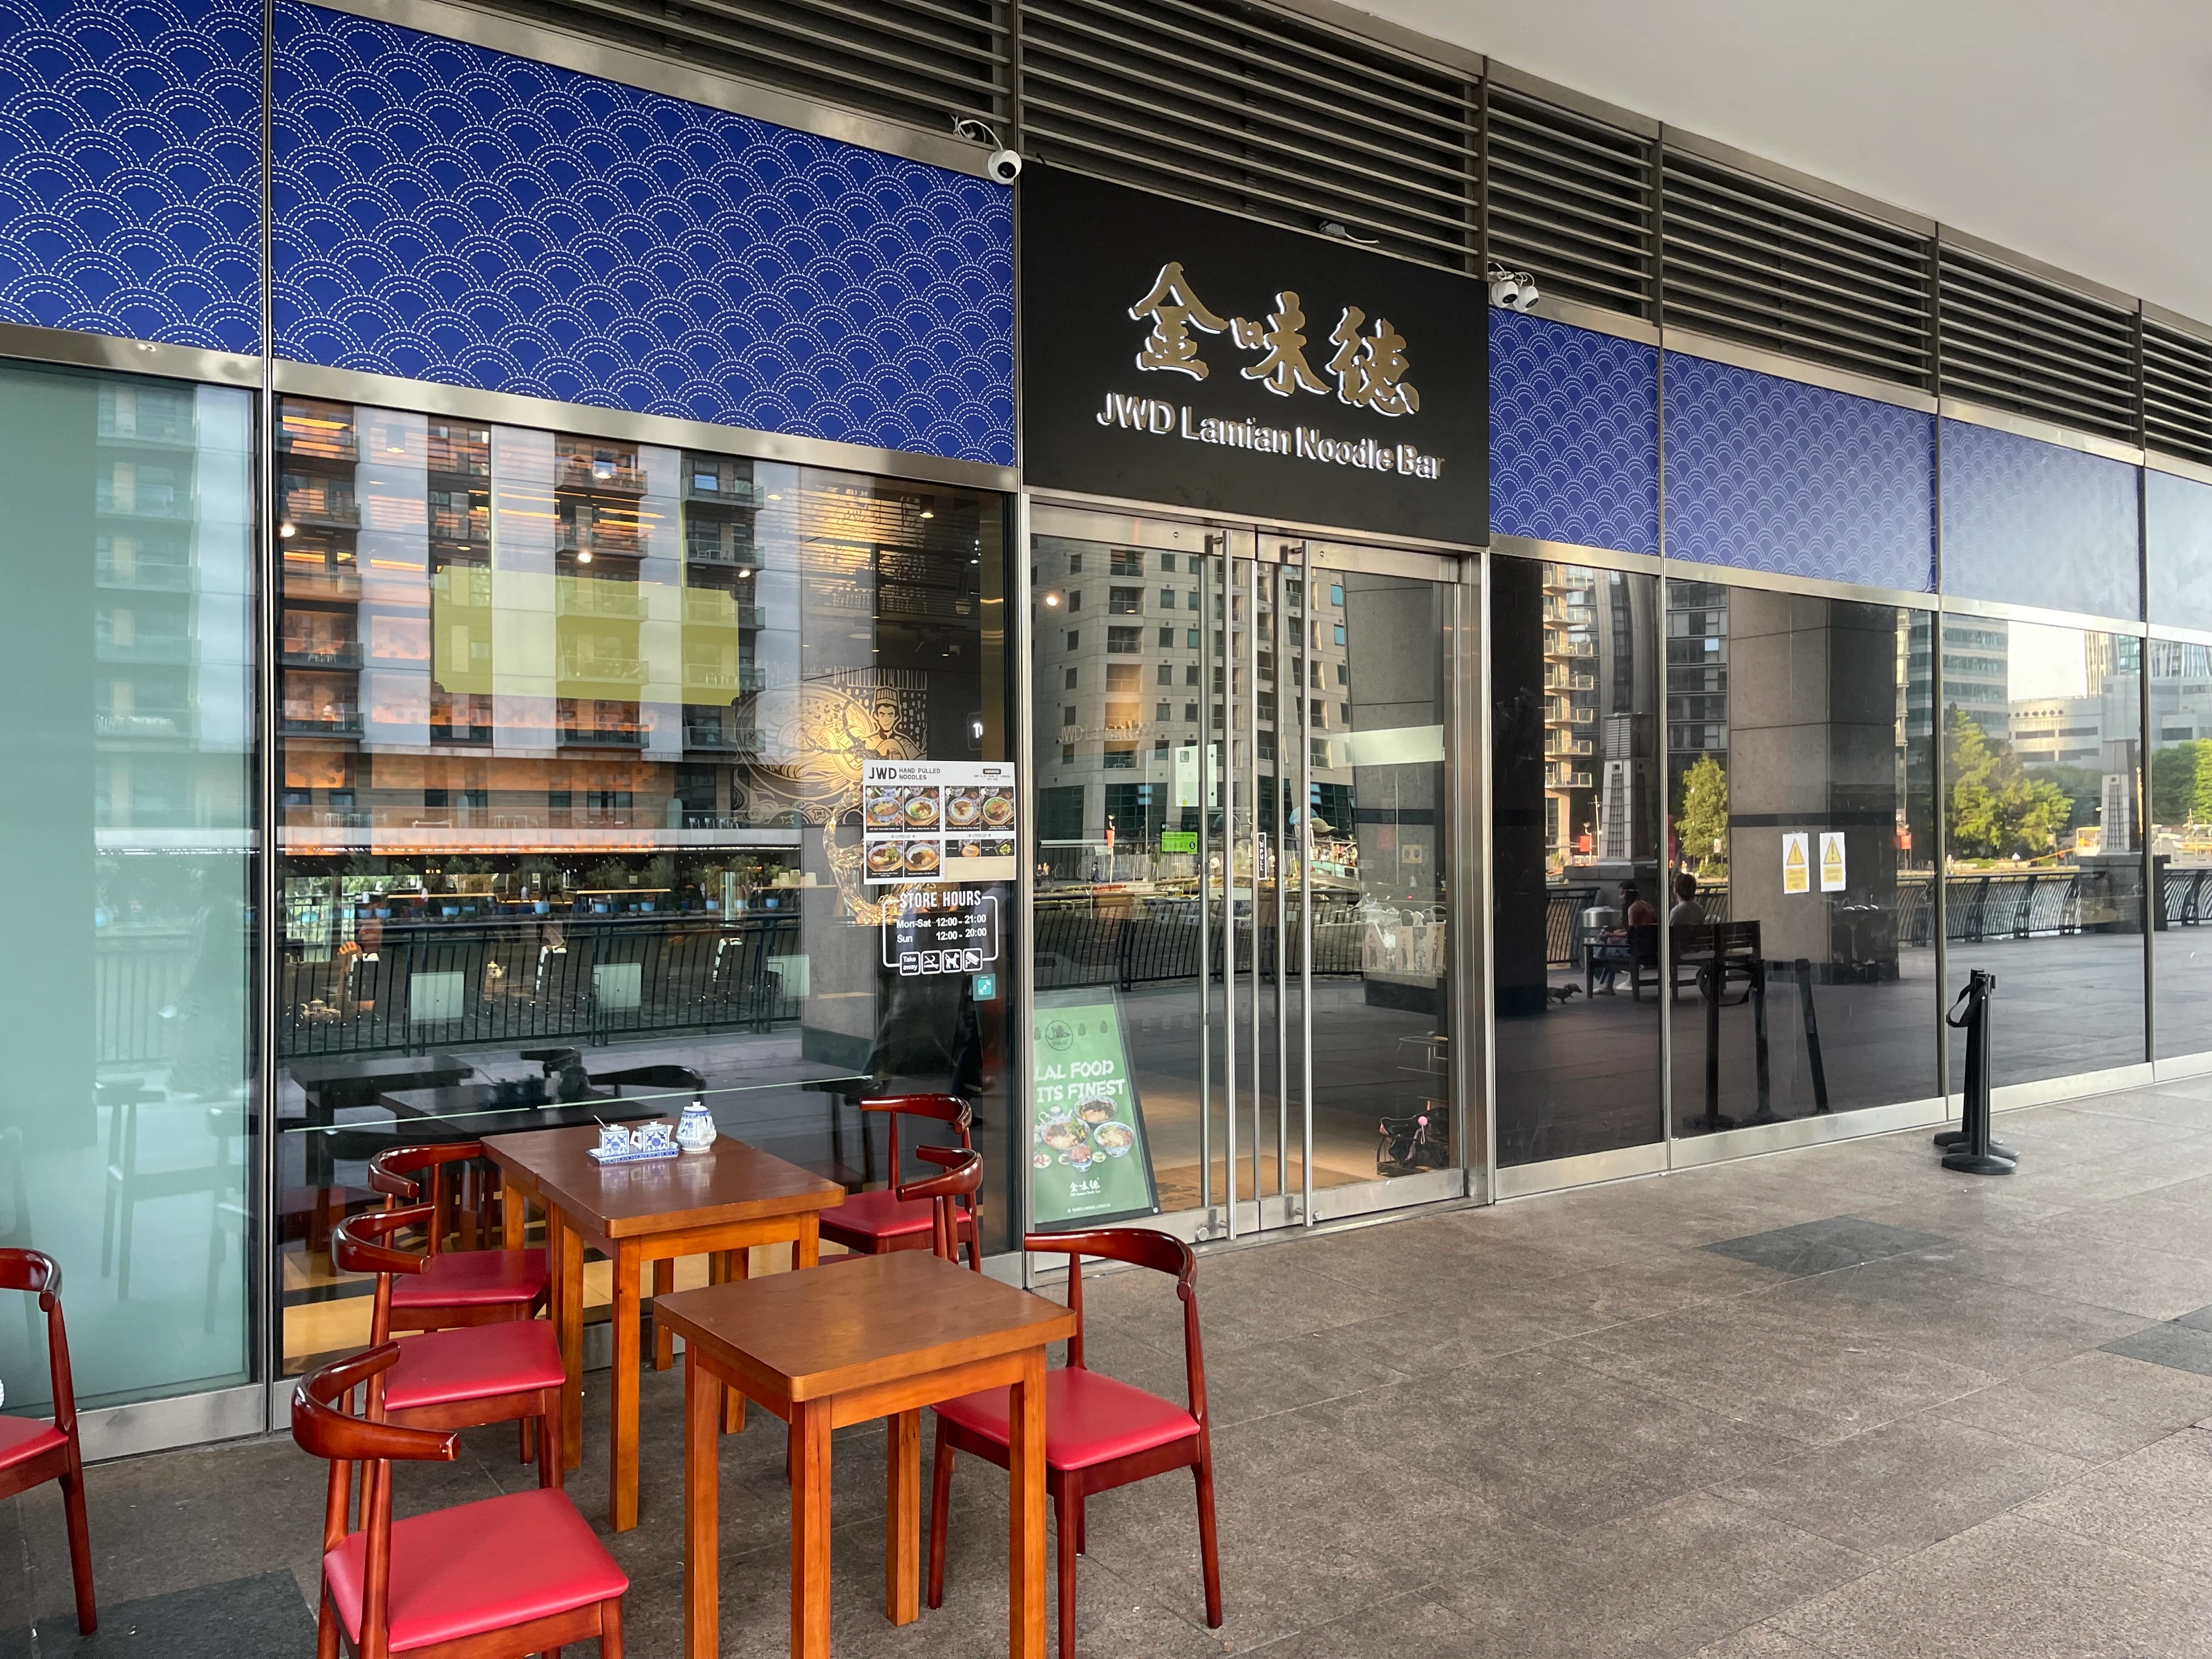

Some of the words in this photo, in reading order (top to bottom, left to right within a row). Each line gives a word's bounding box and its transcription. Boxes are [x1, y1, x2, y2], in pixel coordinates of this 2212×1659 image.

[1096, 393, 1176, 435] JWD
[1181, 406, 1292, 455] Lamian
[1295, 427, 1395, 471] Noodle
[1397, 444, 1445, 480] Bar
[868, 767, 897, 780] JWD
[900, 892, 937, 908] STORE
[943, 890, 981, 907] HOURS
[897, 919, 932, 929] Mon-Sat
[936, 917, 957, 927] 12:00
[964, 914, 986, 924] 21:00
[897, 935, 913, 943] Sun
[936, 930, 957, 941] 12:00
[965, 928, 987, 937] 20:00
[1070, 1059, 1114, 1078] FOOD
[1037, 1085, 1064, 1103] ITS
[1067, 1078, 1125, 1100] FINEST
